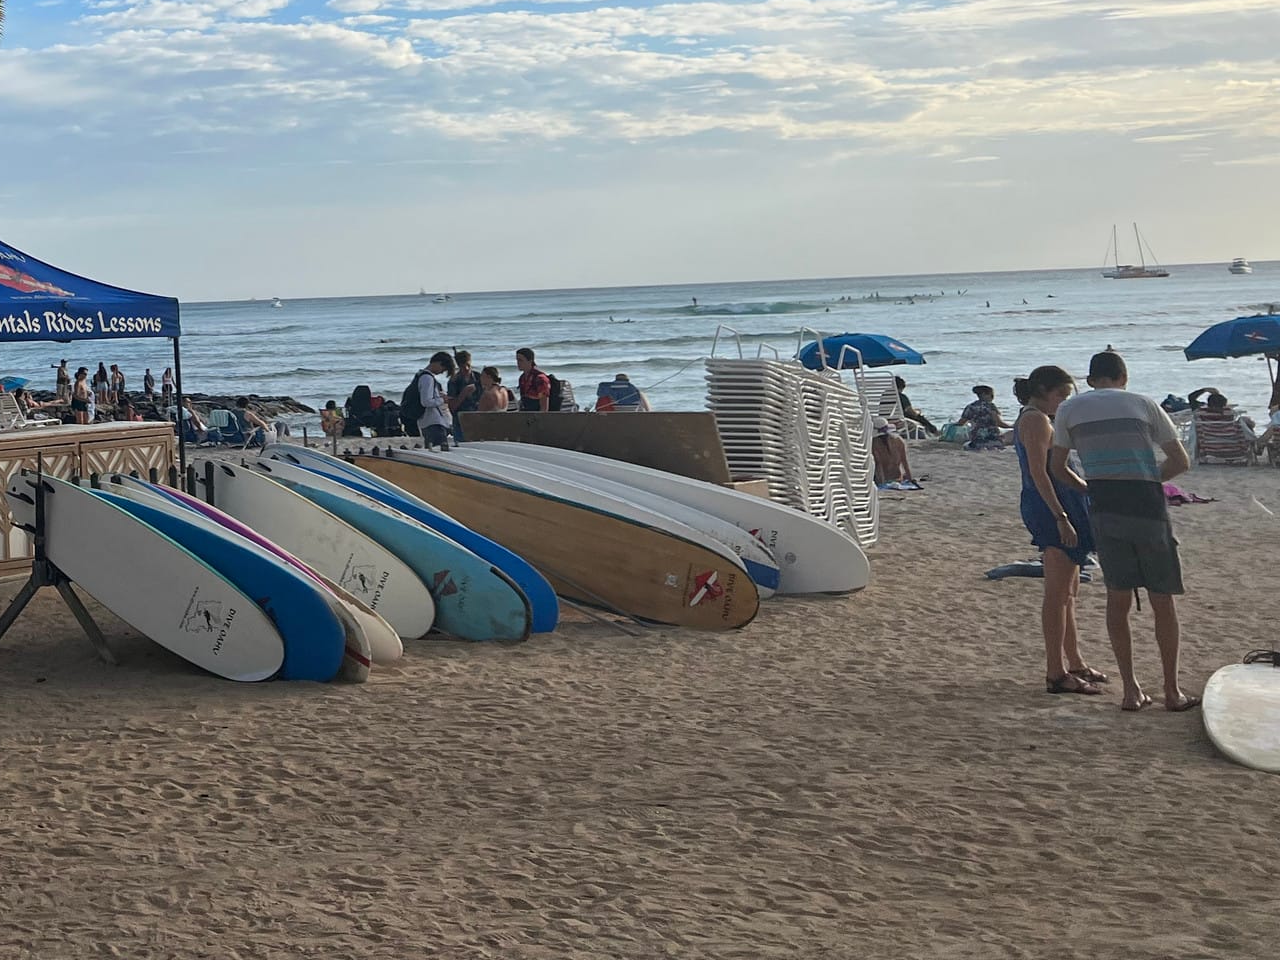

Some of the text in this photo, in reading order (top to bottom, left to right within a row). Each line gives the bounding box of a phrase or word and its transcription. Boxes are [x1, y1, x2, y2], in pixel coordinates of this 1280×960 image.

[43, 311, 94, 333] Rides
[97, 310, 162, 333] Lessons
[377, 571, 389, 589] DIVE
[213, 608, 237, 656] DIVE OAHU
